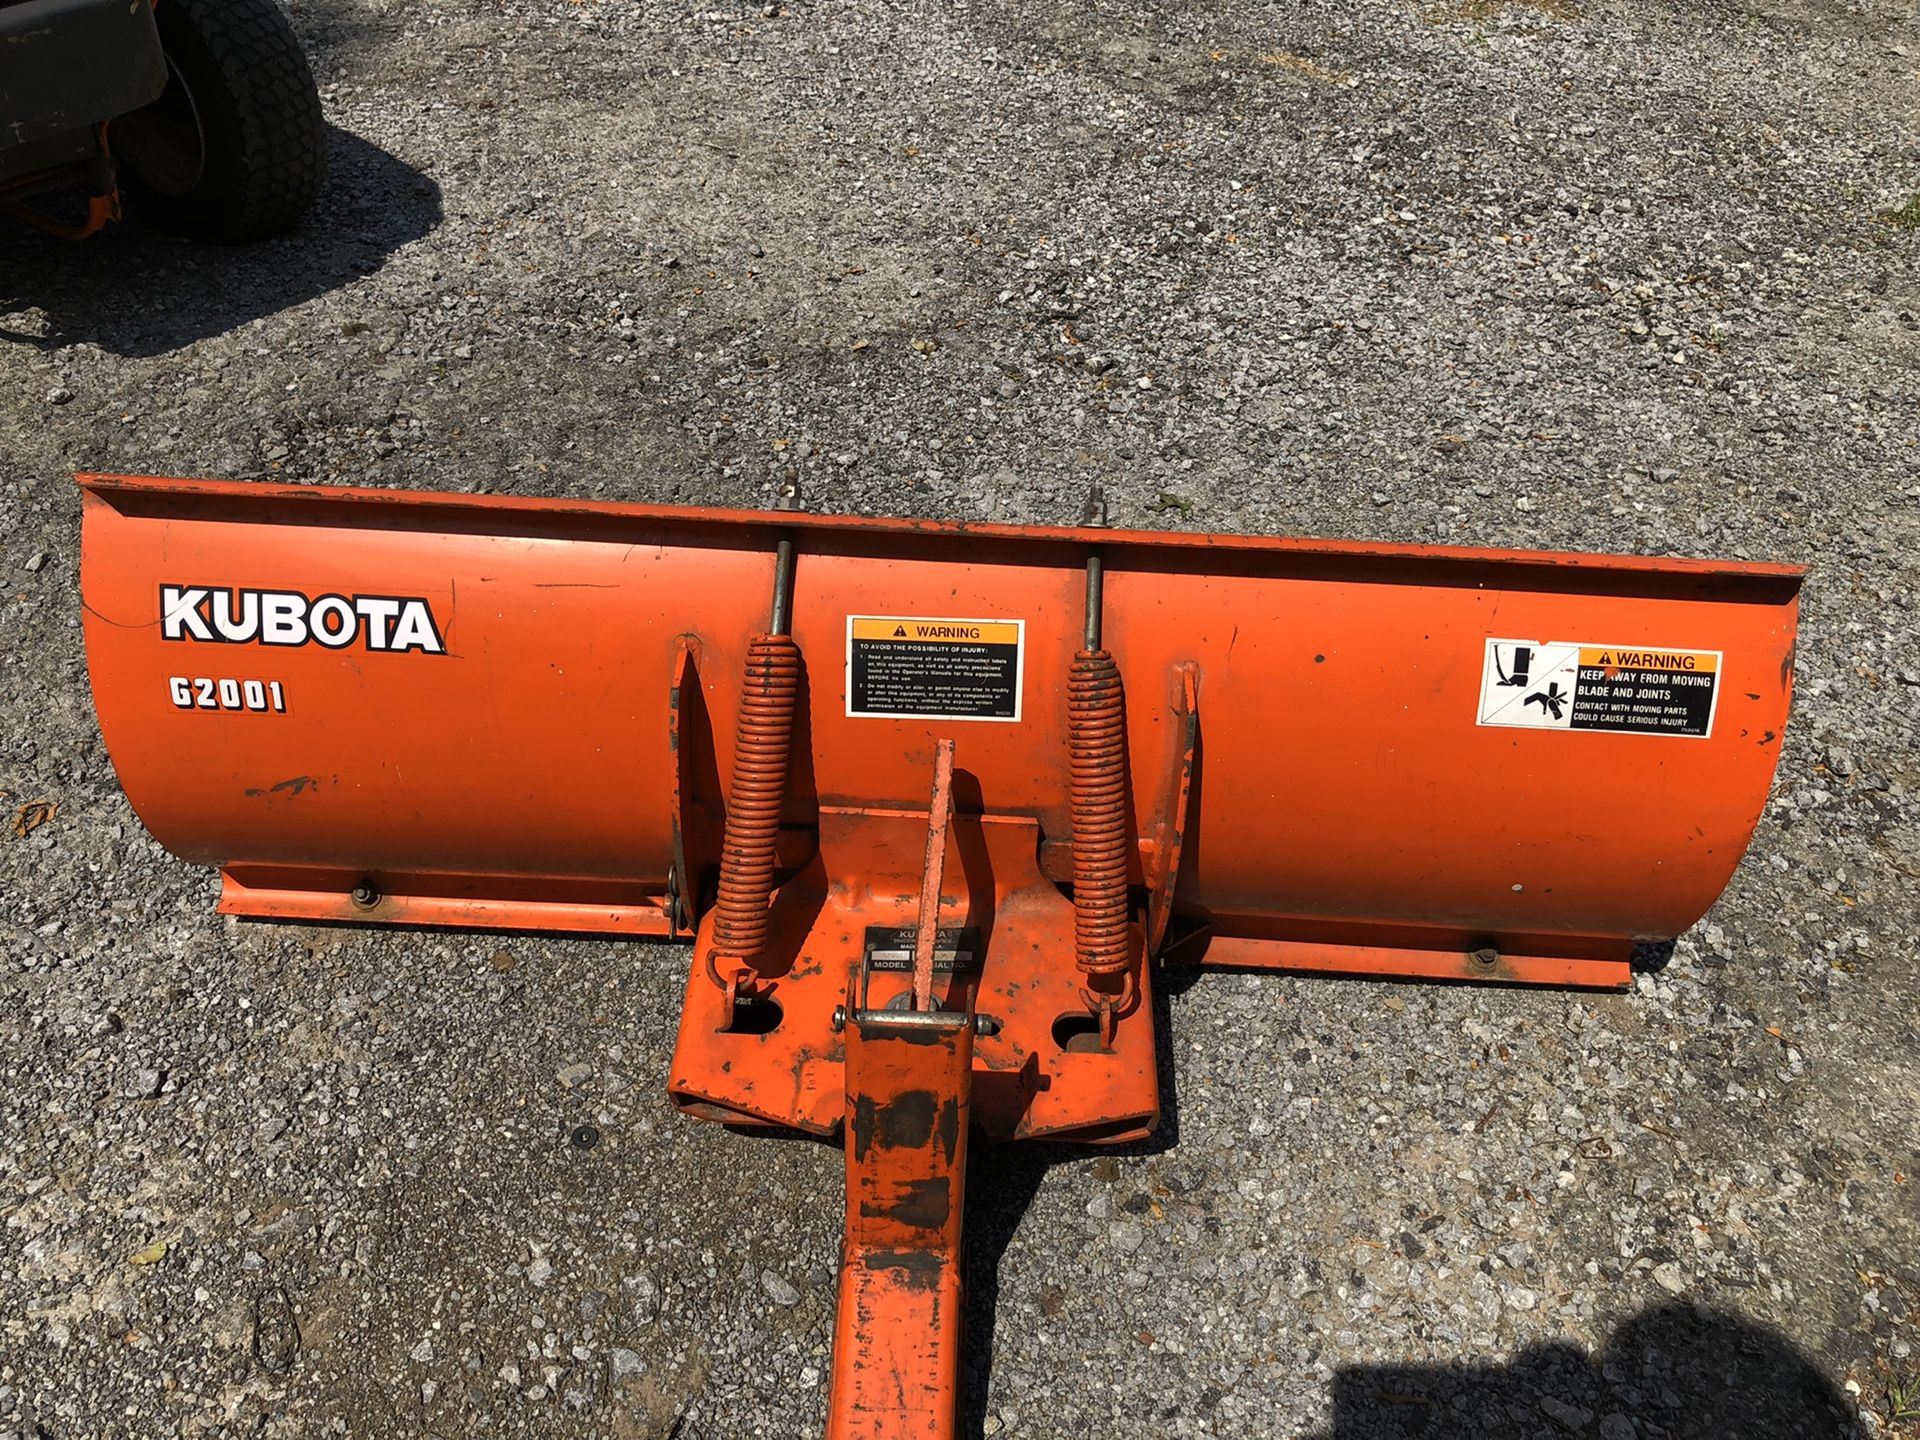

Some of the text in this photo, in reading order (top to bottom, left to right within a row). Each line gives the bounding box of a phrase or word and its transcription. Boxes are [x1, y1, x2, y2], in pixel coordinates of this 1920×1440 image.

[160, 584, 448, 656] KUBOTA
[917, 626, 980, 638] WARNING
[1616, 652, 1695, 669] WARNING
[1580, 670, 1604, 680] KEEP
[1640, 673, 1667, 684] FROM
[1672, 676, 1711, 687] MOVING
[169, 676, 286, 713] G2001
[1578, 686, 1671, 700] BLADE AND JOINTS
[1575, 702, 1688, 715] CONTACT WITH MOVING PARTS
[1574, 713, 1688, 726] COULD CAUSE SERIOUS INJURY
